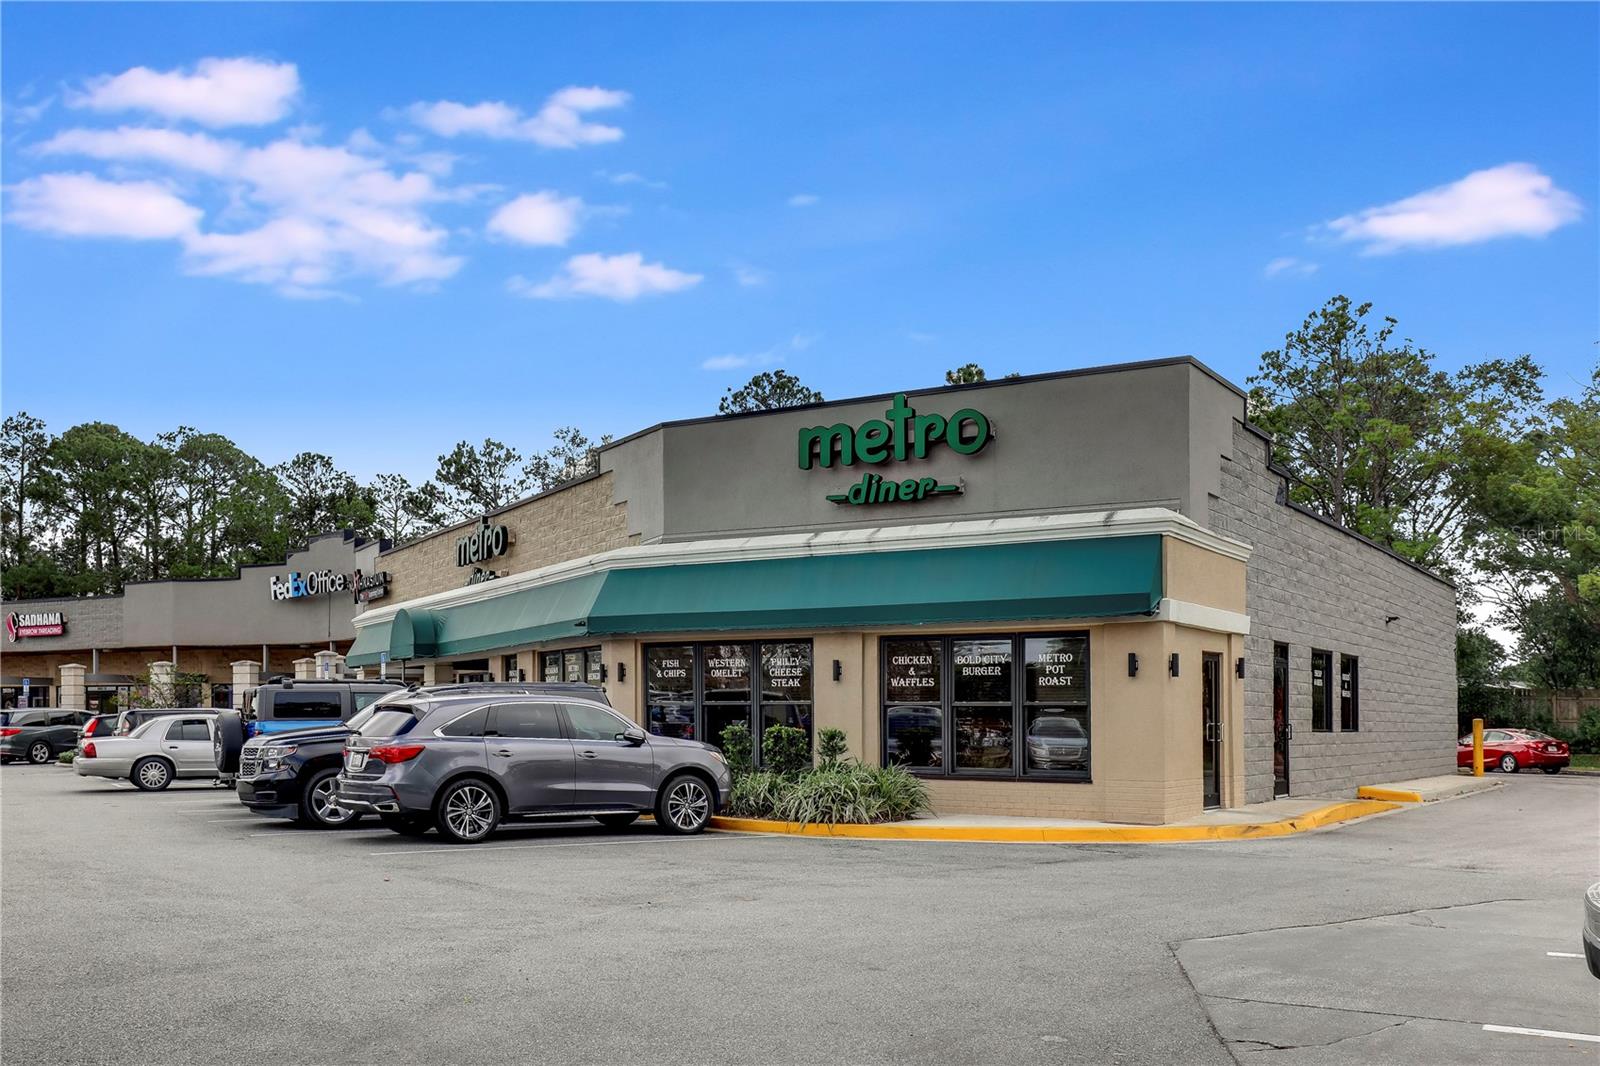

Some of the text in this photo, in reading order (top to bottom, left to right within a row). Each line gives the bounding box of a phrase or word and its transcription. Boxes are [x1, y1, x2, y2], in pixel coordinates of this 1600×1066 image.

[799, 393, 989, 470] metro
[847, 473, 938, 505] diner
[456, 516, 508, 567] metro
[270, 572, 308, 600] FedEx
[307, 570, 344, 594] Office
[19, 612, 62, 627] SADHANA
[708, 658, 746, 668] WESTERN
[771, 657, 801, 666] PHILLY
[892, 655, 933, 665] CHICKEN
[957, 654, 1008, 664] BOLD CITY
[1038, 653, 1073, 663] METRO
[662, 659, 680, 668] FISH
[656, 669, 687, 678] & CHIPS
[711, 669, 743, 678] OMELET
[769, 668, 803, 677] CHEESE
[908, 667, 916, 676] &
[962, 666, 1002, 676] BURGER
[1045, 665, 1066, 674] POT
[771, 678, 801, 687] STEAK
[891, 677, 935, 687] WAFFLES
[1038, 676, 1073, 686] ROAST
